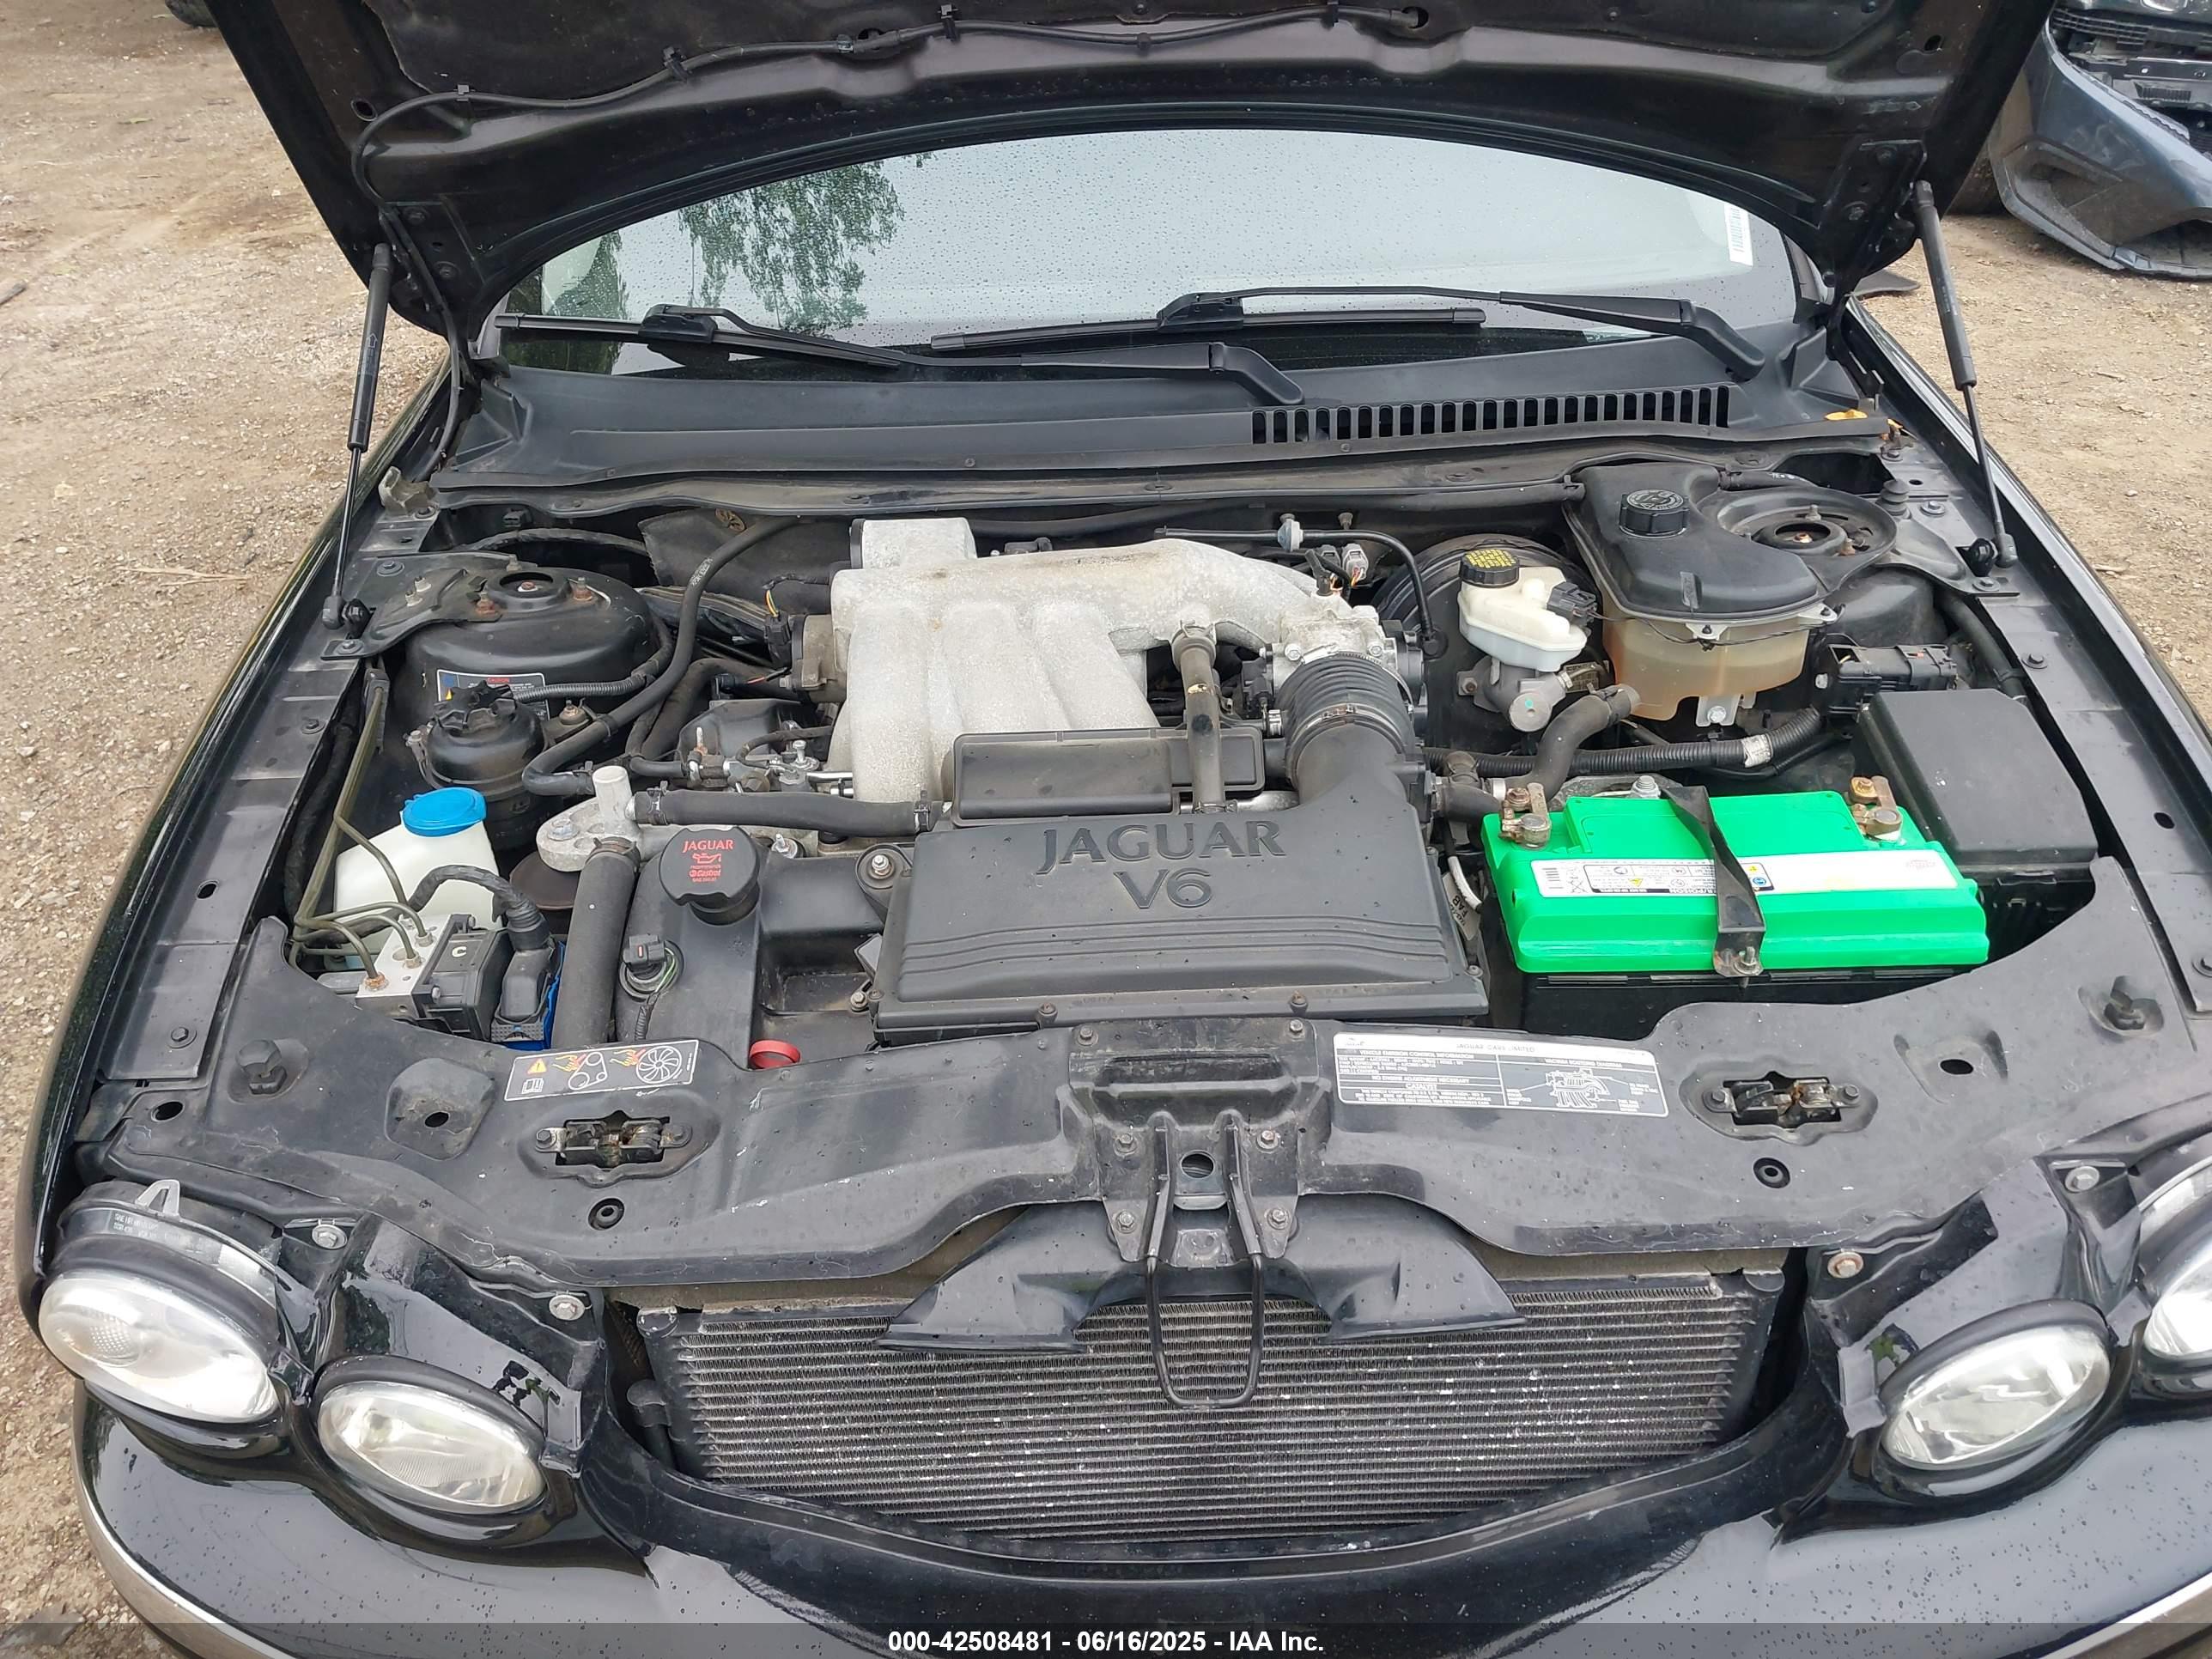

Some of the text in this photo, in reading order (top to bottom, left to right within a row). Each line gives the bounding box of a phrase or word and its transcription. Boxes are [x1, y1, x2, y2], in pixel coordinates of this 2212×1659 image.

[682, 839, 734, 853] JAGUAR
[1036, 820, 1286, 876] JAGUAR
[1112, 866, 1213, 910] V6
[452, 945, 467, 957] C
